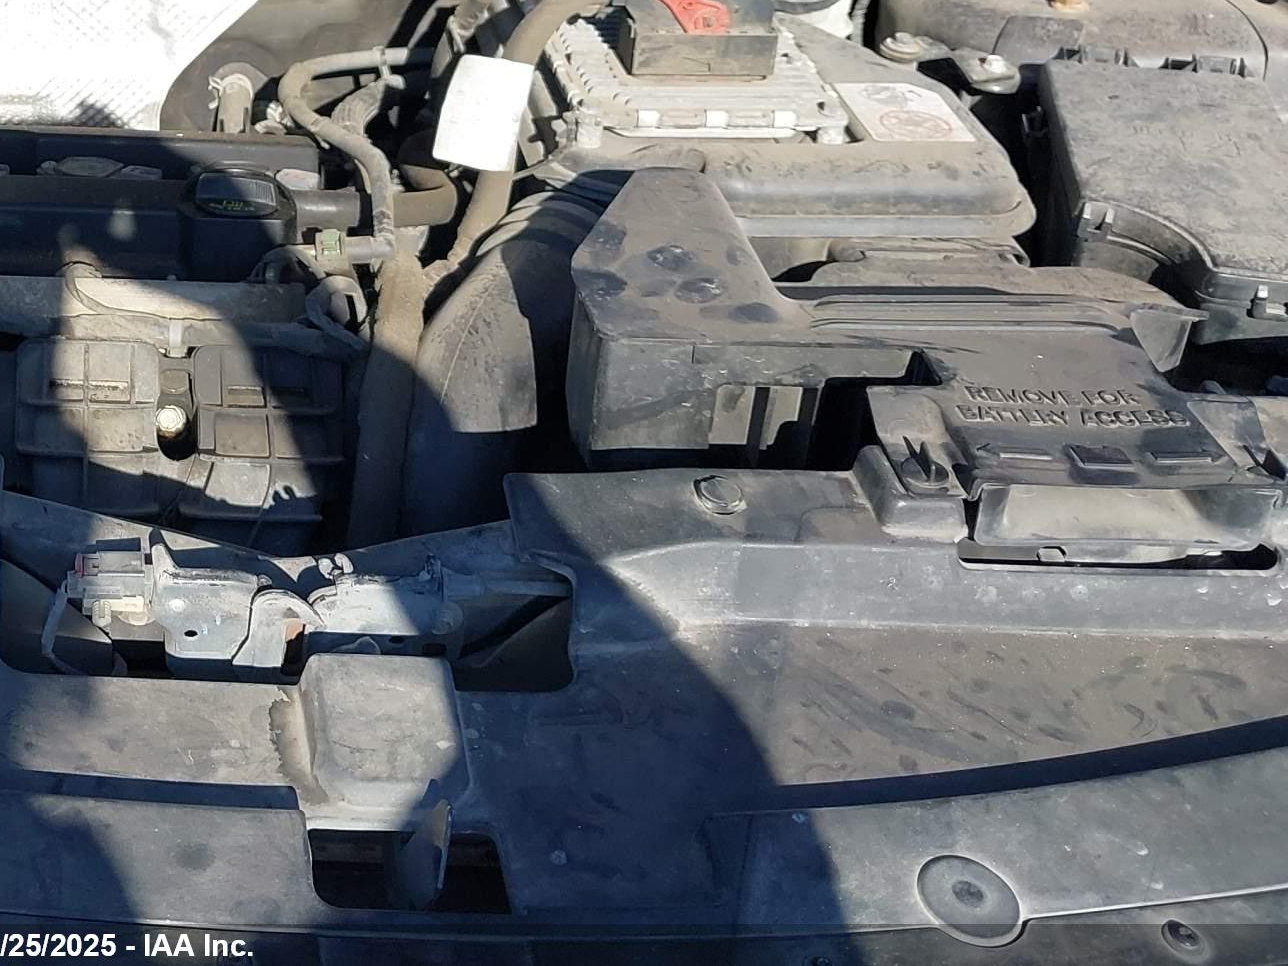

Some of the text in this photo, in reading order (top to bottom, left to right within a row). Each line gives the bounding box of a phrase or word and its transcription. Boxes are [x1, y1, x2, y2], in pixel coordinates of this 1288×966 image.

[964, 385, 1143, 407] REMOVE FOR
[957, 404, 1190, 427] BATTERY ACCESS
